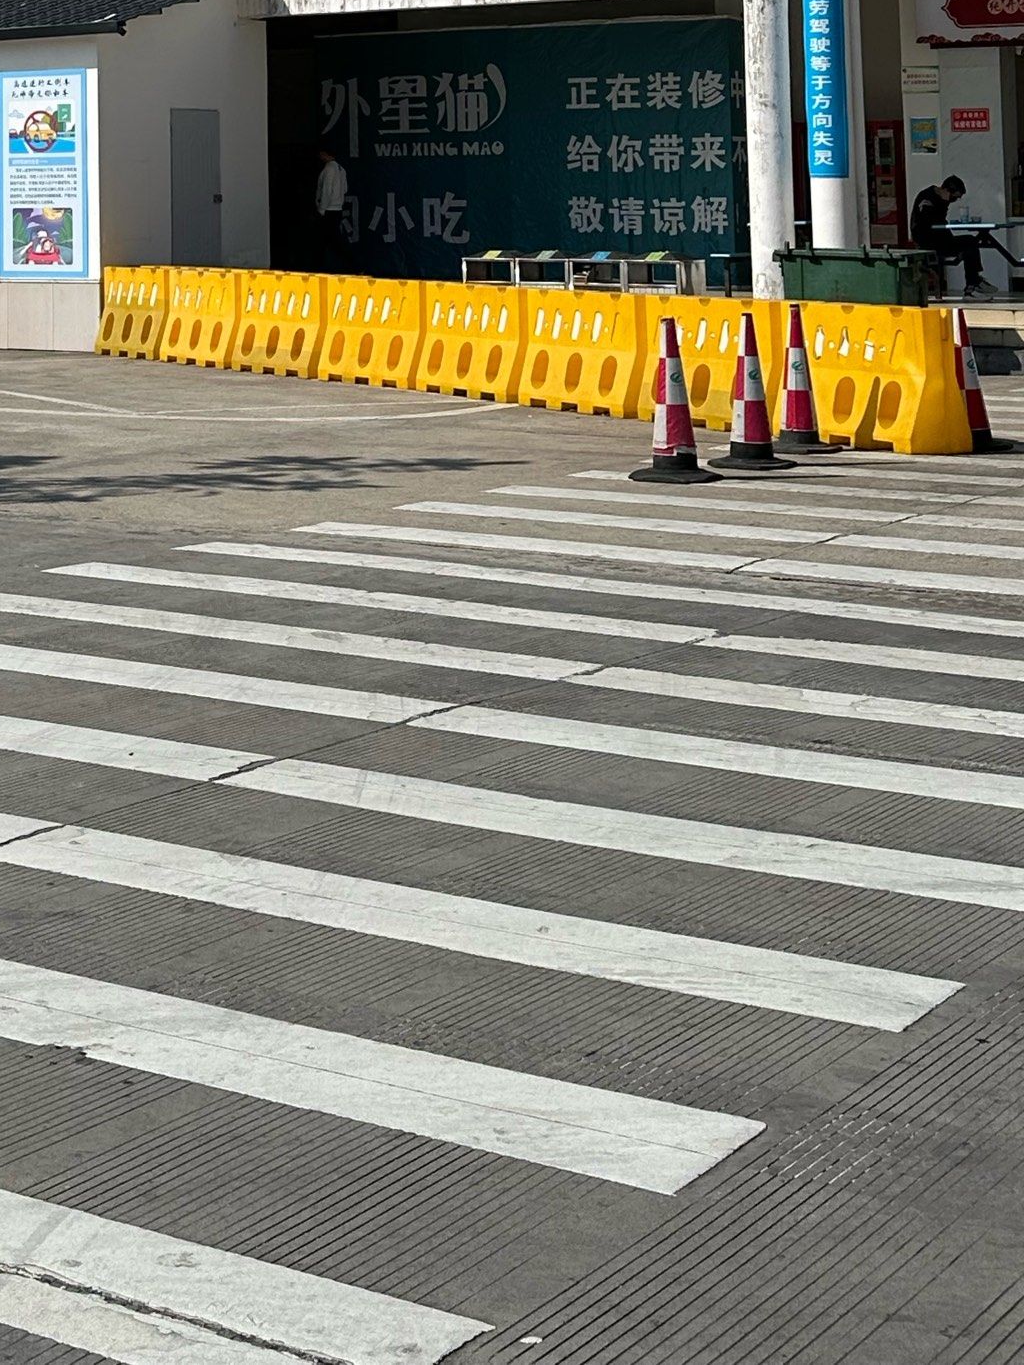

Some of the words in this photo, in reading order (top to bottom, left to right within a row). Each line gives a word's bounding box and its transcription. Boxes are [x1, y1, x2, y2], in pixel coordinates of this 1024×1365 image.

[566, 69, 745, 111] 正在装修中
[374, 143, 410, 157] WAI
[411, 142, 458, 157] XING
[462, 140, 505, 156] MAO
